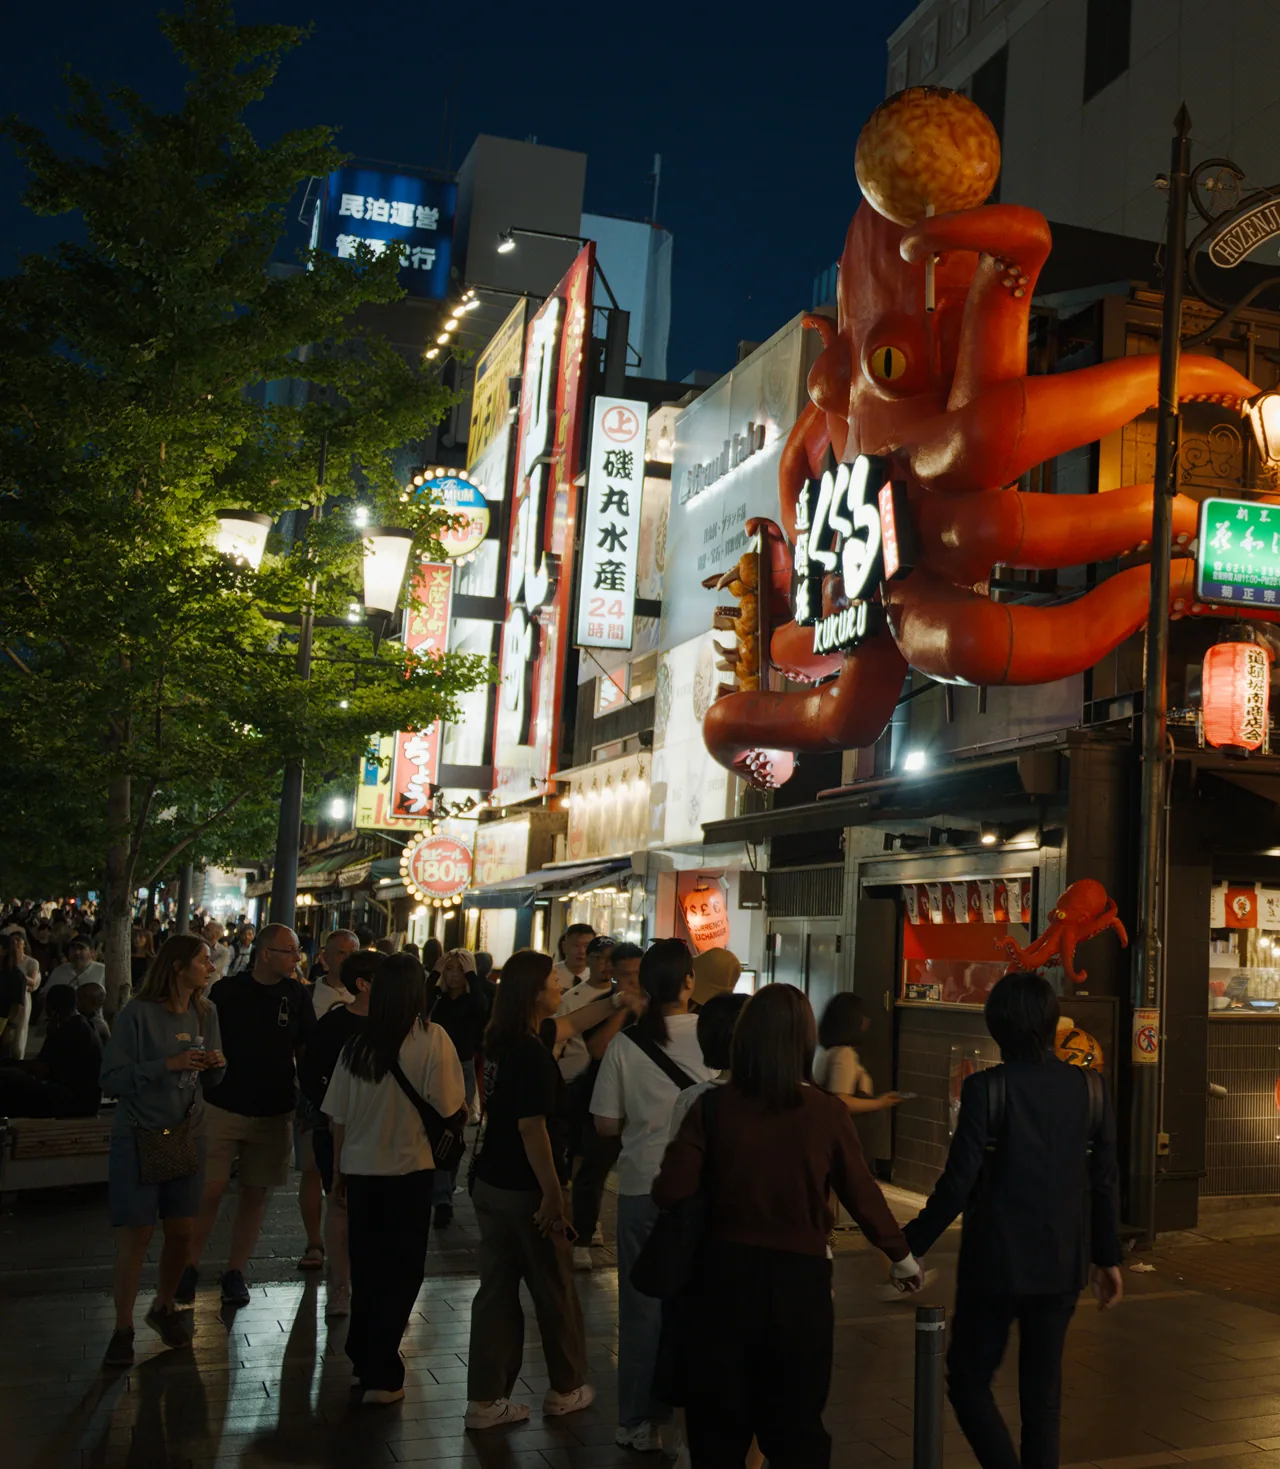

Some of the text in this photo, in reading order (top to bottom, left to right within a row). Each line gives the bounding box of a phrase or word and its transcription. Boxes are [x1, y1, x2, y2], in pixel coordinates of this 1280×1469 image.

[339, 193, 440, 230] 民泊運営
[593, 448, 633, 593] 磯丸水産
[588, 597, 625, 620] 24
[588, 622, 624, 641] 時間
[812, 602, 868, 654] KUKURU
[415, 860, 469, 883] 180円
